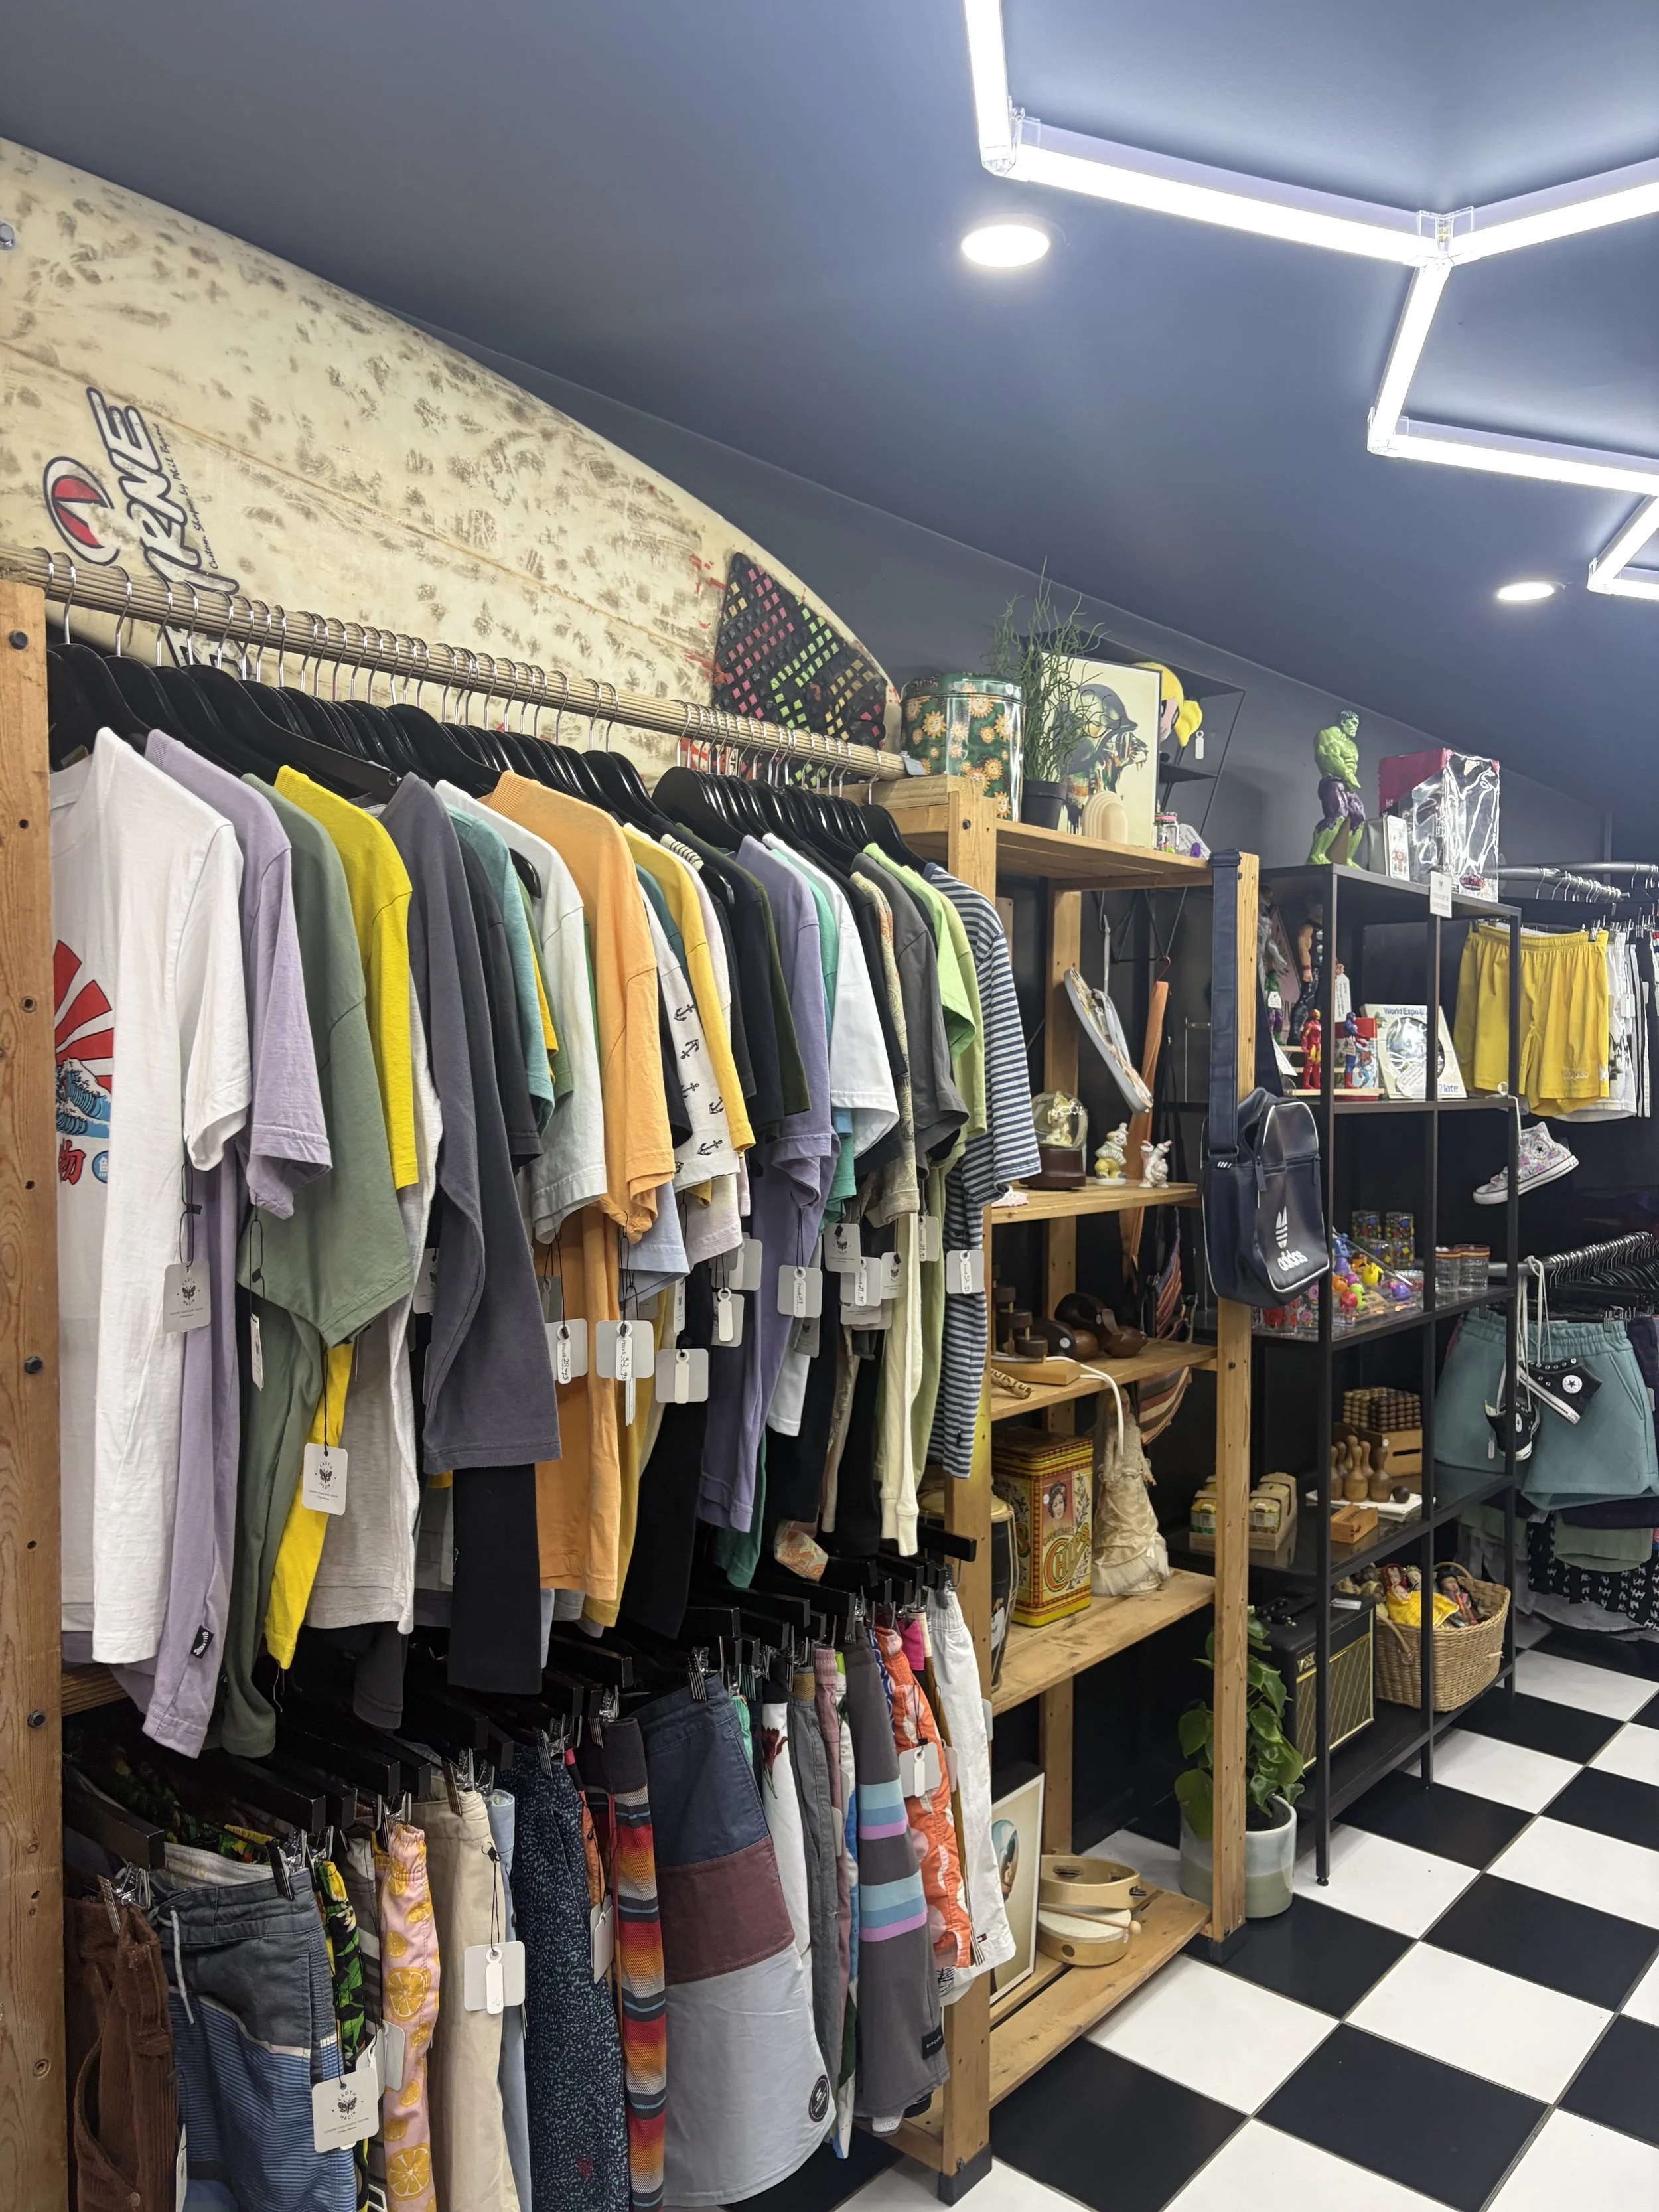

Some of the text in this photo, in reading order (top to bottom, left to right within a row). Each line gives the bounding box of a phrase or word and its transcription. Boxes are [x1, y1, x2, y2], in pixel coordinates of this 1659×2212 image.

[179, 483, 189, 496] by
[202, 535, 218, 569] Custom
[1403, 1007, 1419, 1017] Expo
[1277, 1250, 1308, 1271] adidas
[338, 2091, 357, 2120] EARTH MAGIK
